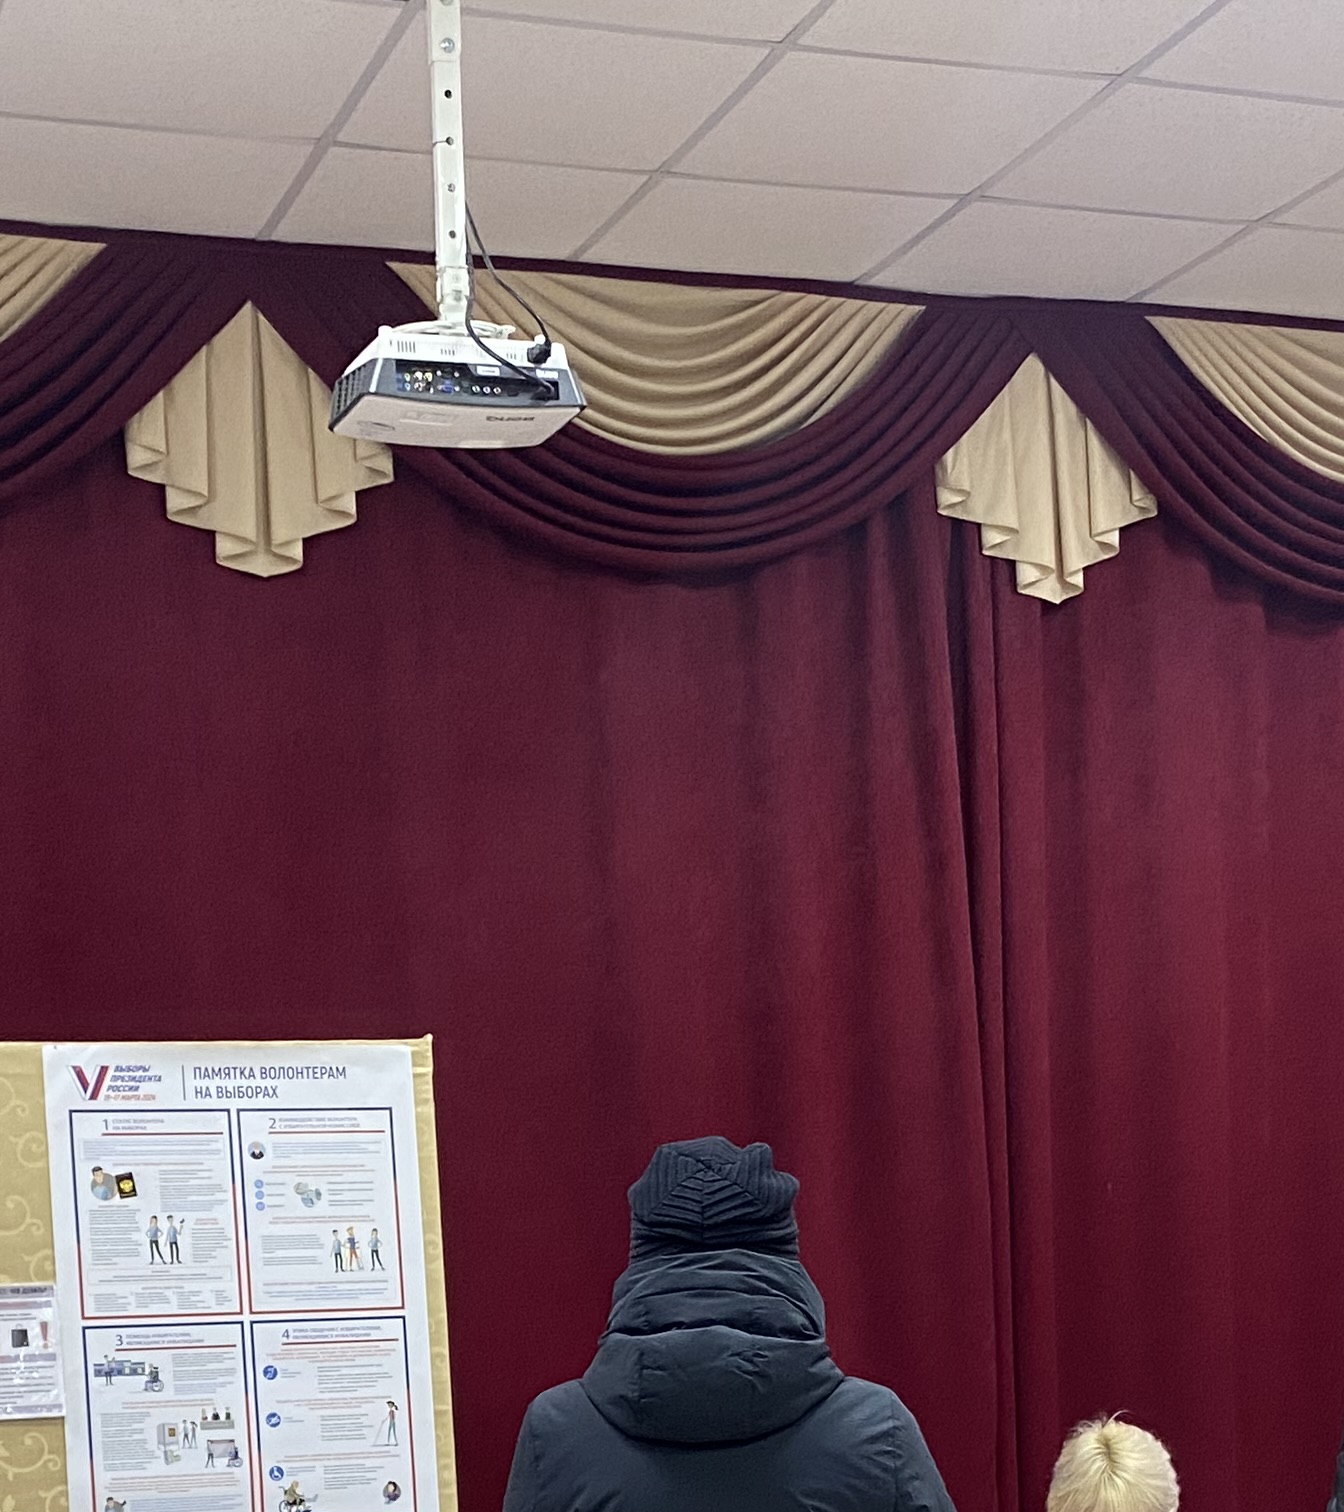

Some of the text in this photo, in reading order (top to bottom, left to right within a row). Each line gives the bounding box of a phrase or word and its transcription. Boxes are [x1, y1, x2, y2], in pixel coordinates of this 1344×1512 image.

[193, 1065, 347, 1080] ПАМЯТКА ВОЛОНТЕРАМ
[194, 1085, 279, 1099] НА ВЫБОРАХ
[102, 1118, 109, 1130] 1
[268, 1117, 277, 1129] 2
[115, 1334, 124, 1346] 3
[281, 1329, 290, 1340] 4
